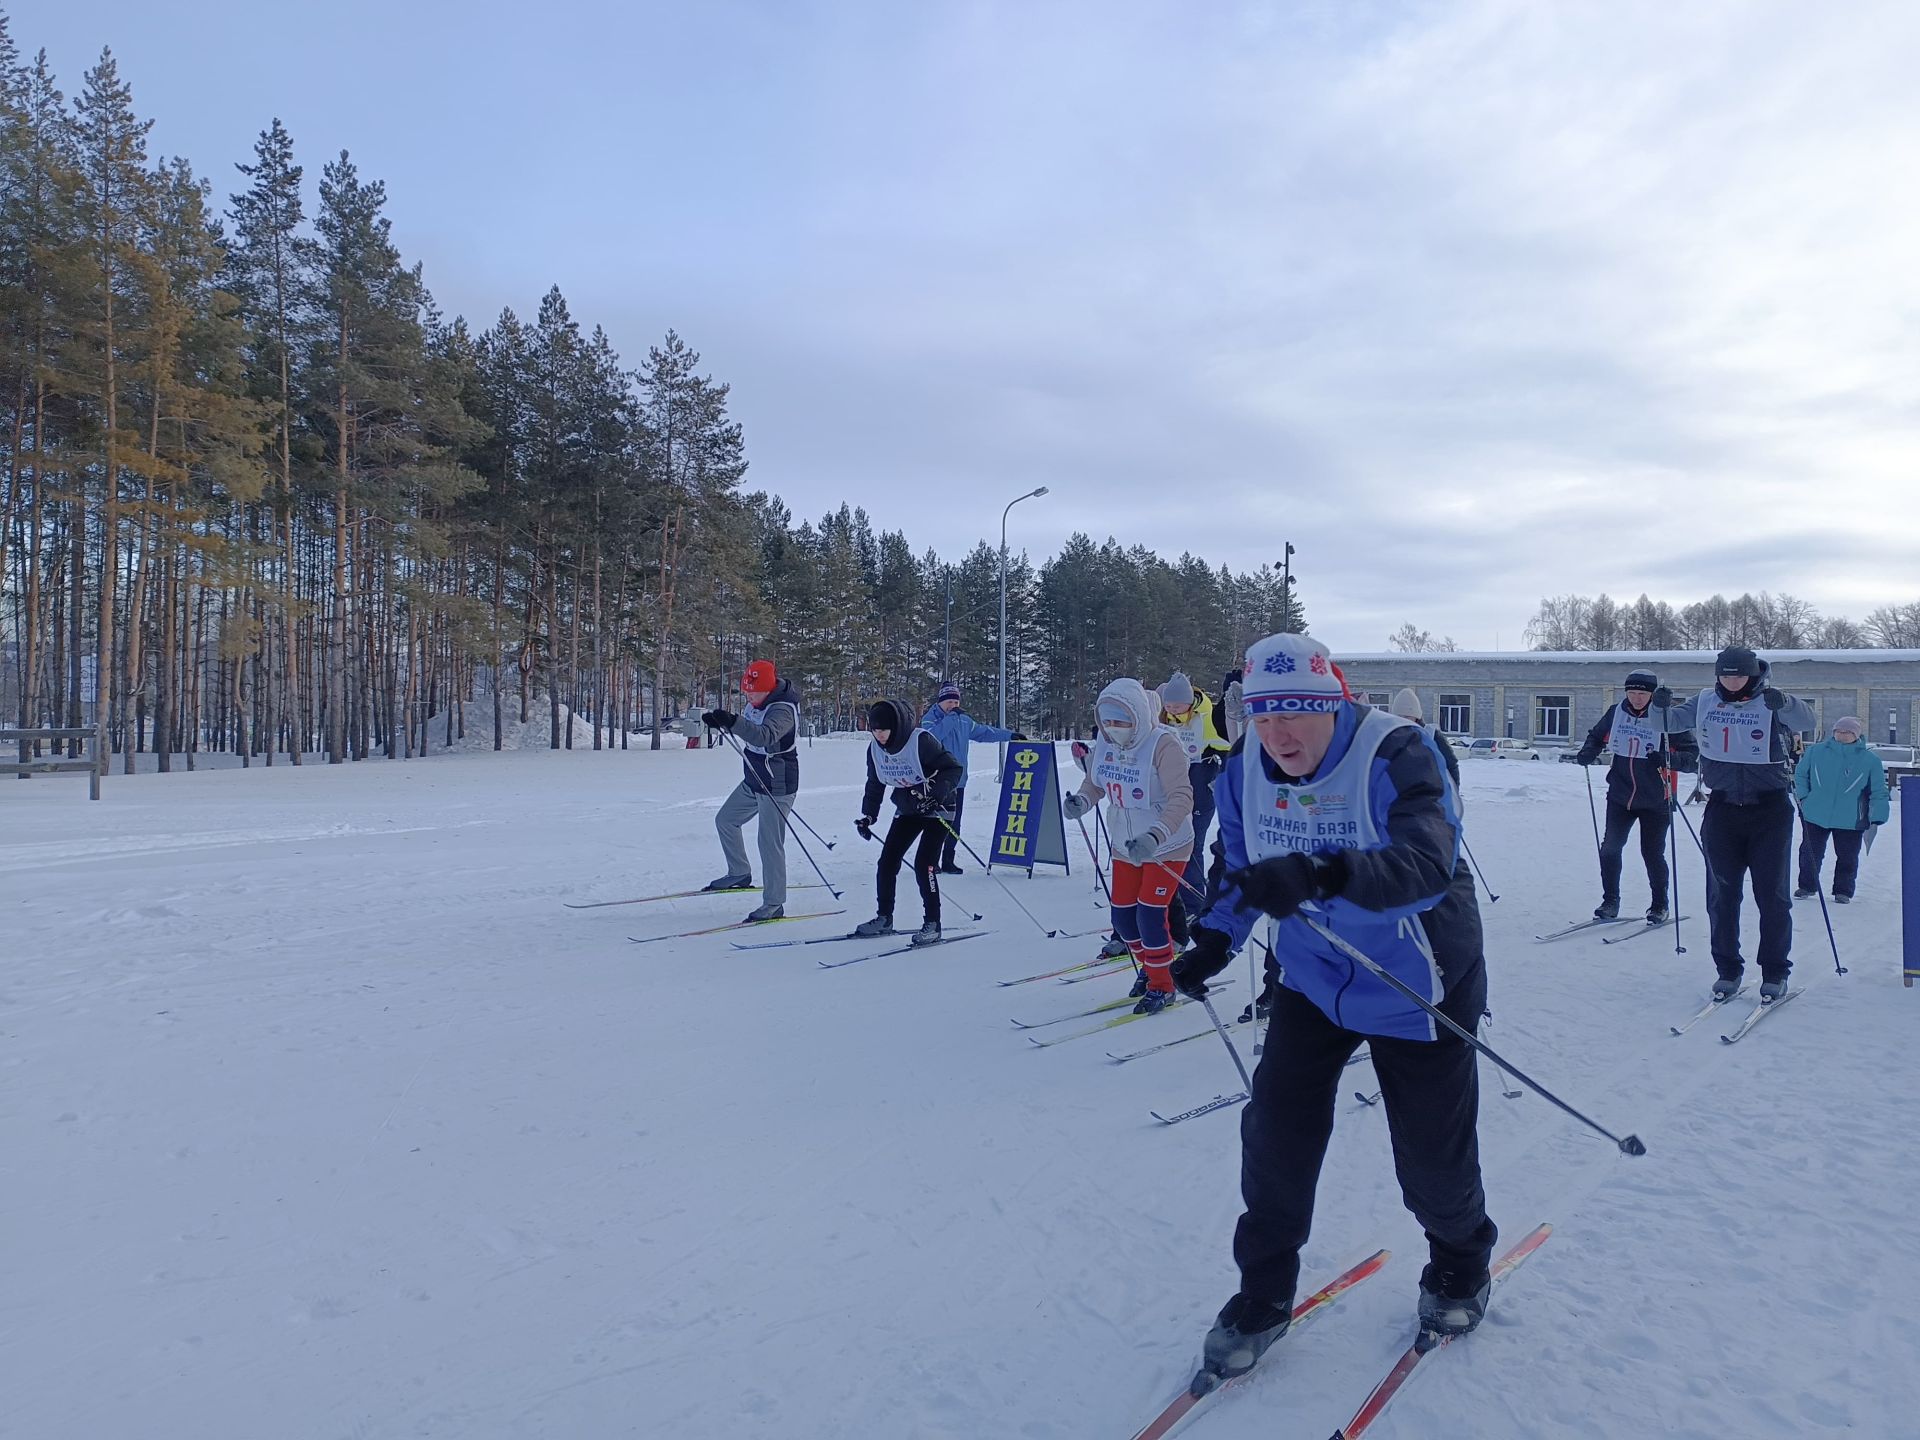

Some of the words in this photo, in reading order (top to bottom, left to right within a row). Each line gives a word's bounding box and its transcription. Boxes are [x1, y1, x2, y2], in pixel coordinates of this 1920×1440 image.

[1722, 726, 1729, 753] 1
[998, 748, 1040, 857] ФИНИШ
[1317, 820, 1358, 836] БАЗА
